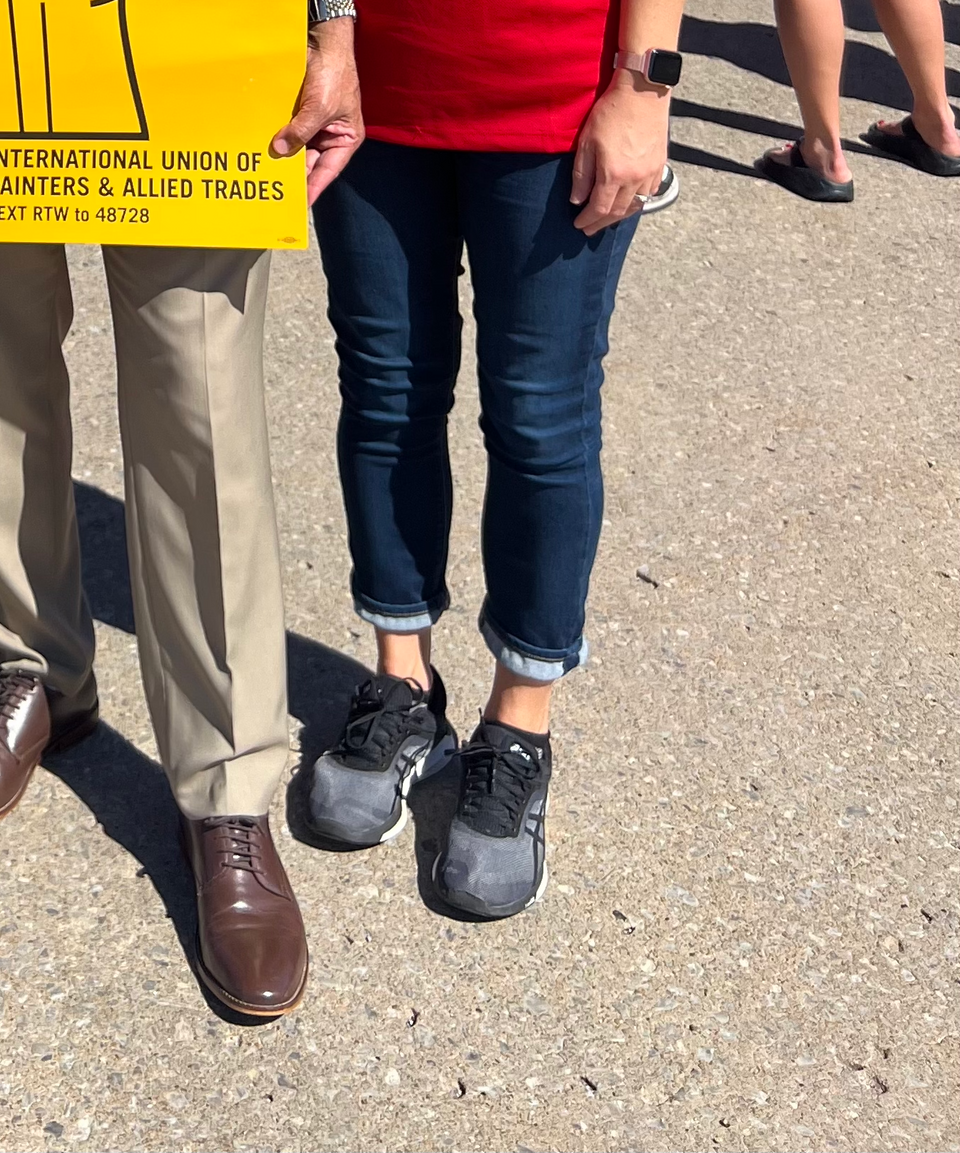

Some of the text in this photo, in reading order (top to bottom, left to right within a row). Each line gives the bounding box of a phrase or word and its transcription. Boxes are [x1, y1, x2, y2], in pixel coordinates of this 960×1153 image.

[161, 150, 228, 171] UNION
[236, 151, 263, 172] OF
[98, 176, 115, 198] &
[122, 177, 193, 199] ALLIED
[201, 179, 285, 201] TRADES
[33, 206, 70, 222] RTW
[75, 208, 90, 223] to
[95, 207, 150, 223] 48728
